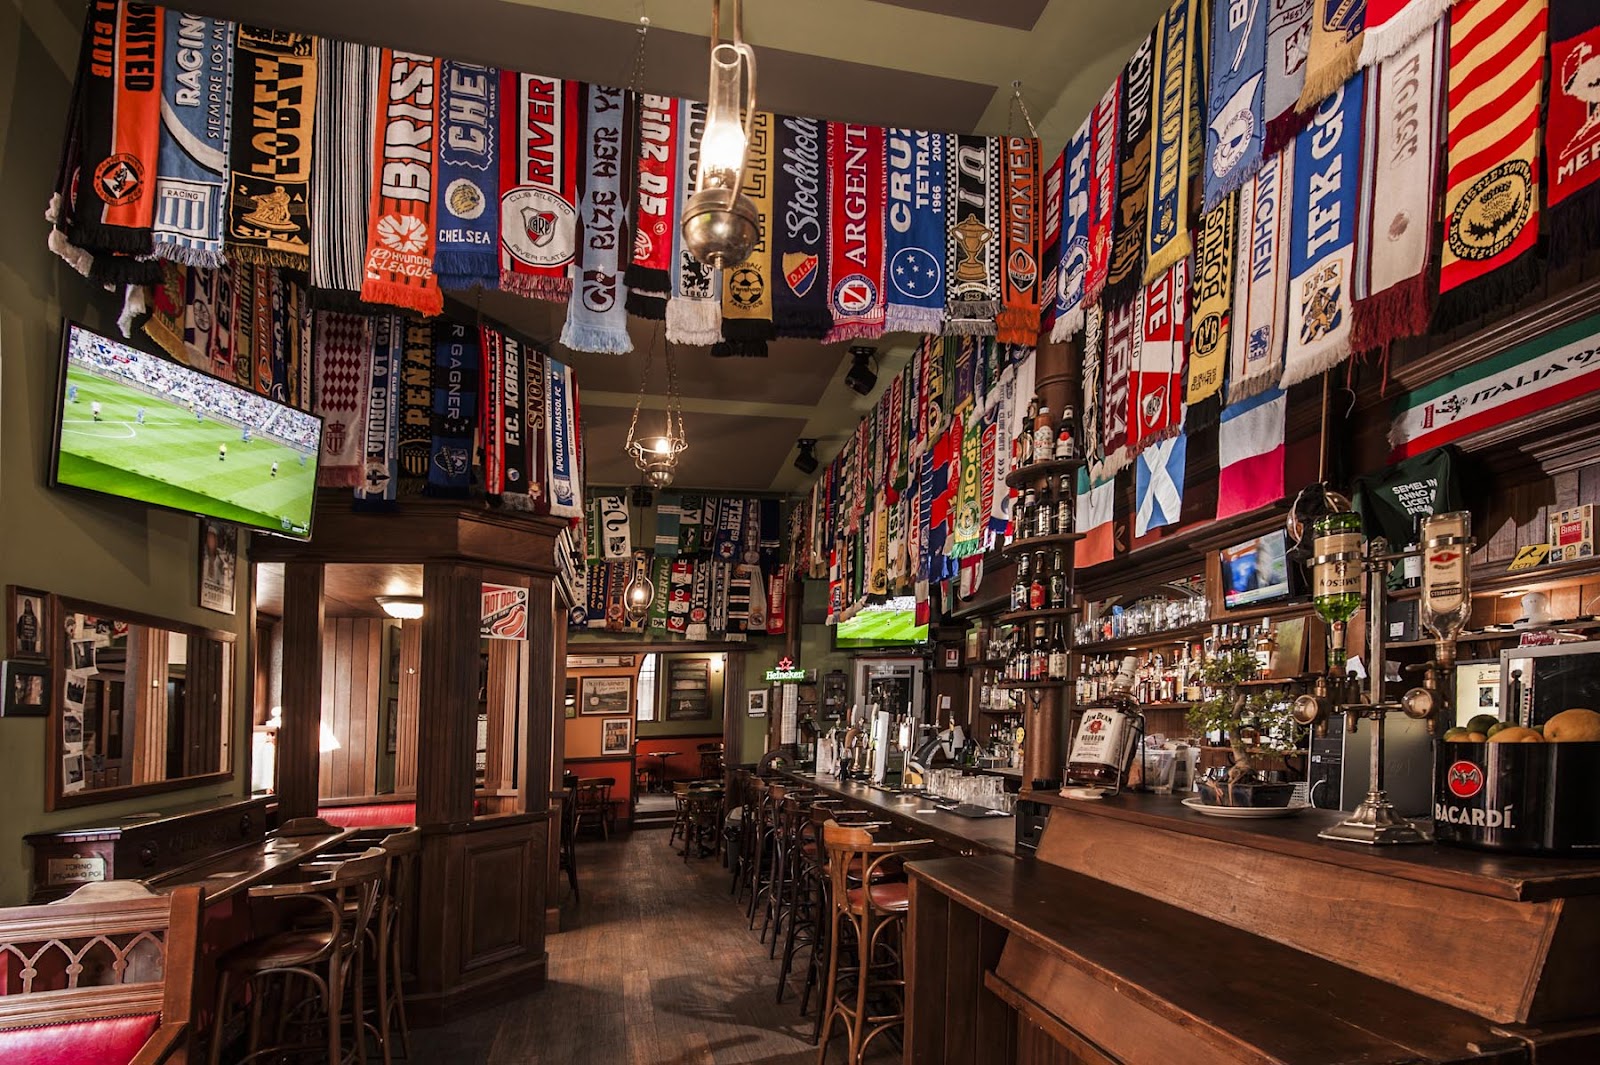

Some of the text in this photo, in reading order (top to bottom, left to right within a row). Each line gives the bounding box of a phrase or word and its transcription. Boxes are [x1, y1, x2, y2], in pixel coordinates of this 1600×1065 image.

[1282, 7, 1304, 23] WEST
[91, 21, 113, 78] CLUB
[211, 44, 223, 72] LOS
[207, 76, 223, 139] SIEMPRE
[527, 77, 555, 186] RIVER
[592, 127, 619, 178] HER
[931, 132, 942, 214] 1966 2003
[1503, 160, 1531, 197] FOOTBALL
[166, 189, 199, 201] RACING
[509, 191, 531, 203] CLUB
[1044, 167, 1062, 240] NEW
[1306, 153, 1343, 260] IFK
[1452, 171, 1499, 224] THISTLE
[439, 228, 491, 244] CHELSEA
[1240, 189, 1251, 254] GERMANY
[391, 251, 432, 267] HYUNDAI
[1449, 224, 1487, 261] PARTICK
[367, 257, 433, 279] A-LEAGUE
[373, 354, 388, 378] LA
[447, 343, 463, 420] GAGNER
[1470, 363, 1569, 405] ITALIA
[504, 336, 520, 447] F.C. KØBEN
[526, 358, 545, 430] IRONS
[554, 386, 565, 472] APOLLON LIMASSOL FC
[997, 432, 1005, 452] PORTO
[963, 437, 977, 500] SPOR
[1391, 478, 1438, 495] SEMEL IN
[1398, 489, 1428, 502] ANNO
[1401, 497, 1431, 508] LICET
[1560, 523, 1581, 535] BIRRE
[484, 590, 516, 616] HOT DOG
[590, 564, 599, 610] Meadow
[695, 562, 706, 607] PAULI
[765, 670, 805, 681] Heineken
[1083, 712, 1113, 725] JIM BEAM
[1081, 734, 1106, 742] BOURBON
[64, 863, 92, 871] TORNO
